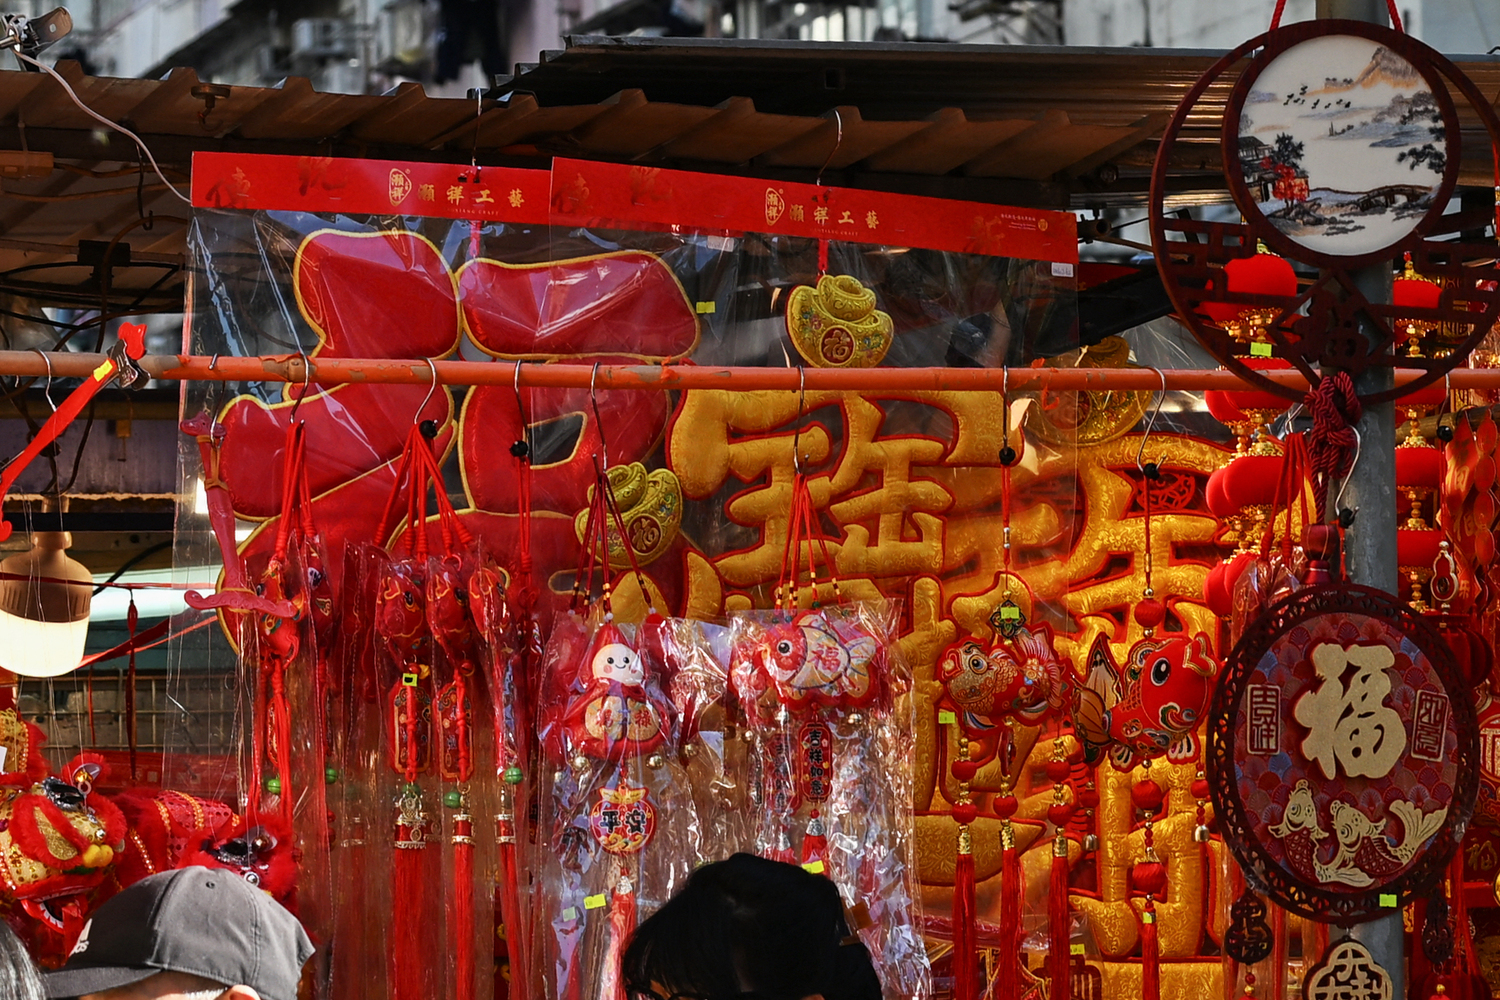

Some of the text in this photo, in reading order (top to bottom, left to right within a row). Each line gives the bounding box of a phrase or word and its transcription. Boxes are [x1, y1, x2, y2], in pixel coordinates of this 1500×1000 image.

[1293, 641, 1407, 781] 福
[807, 730, 825, 796] 吉祥如意
